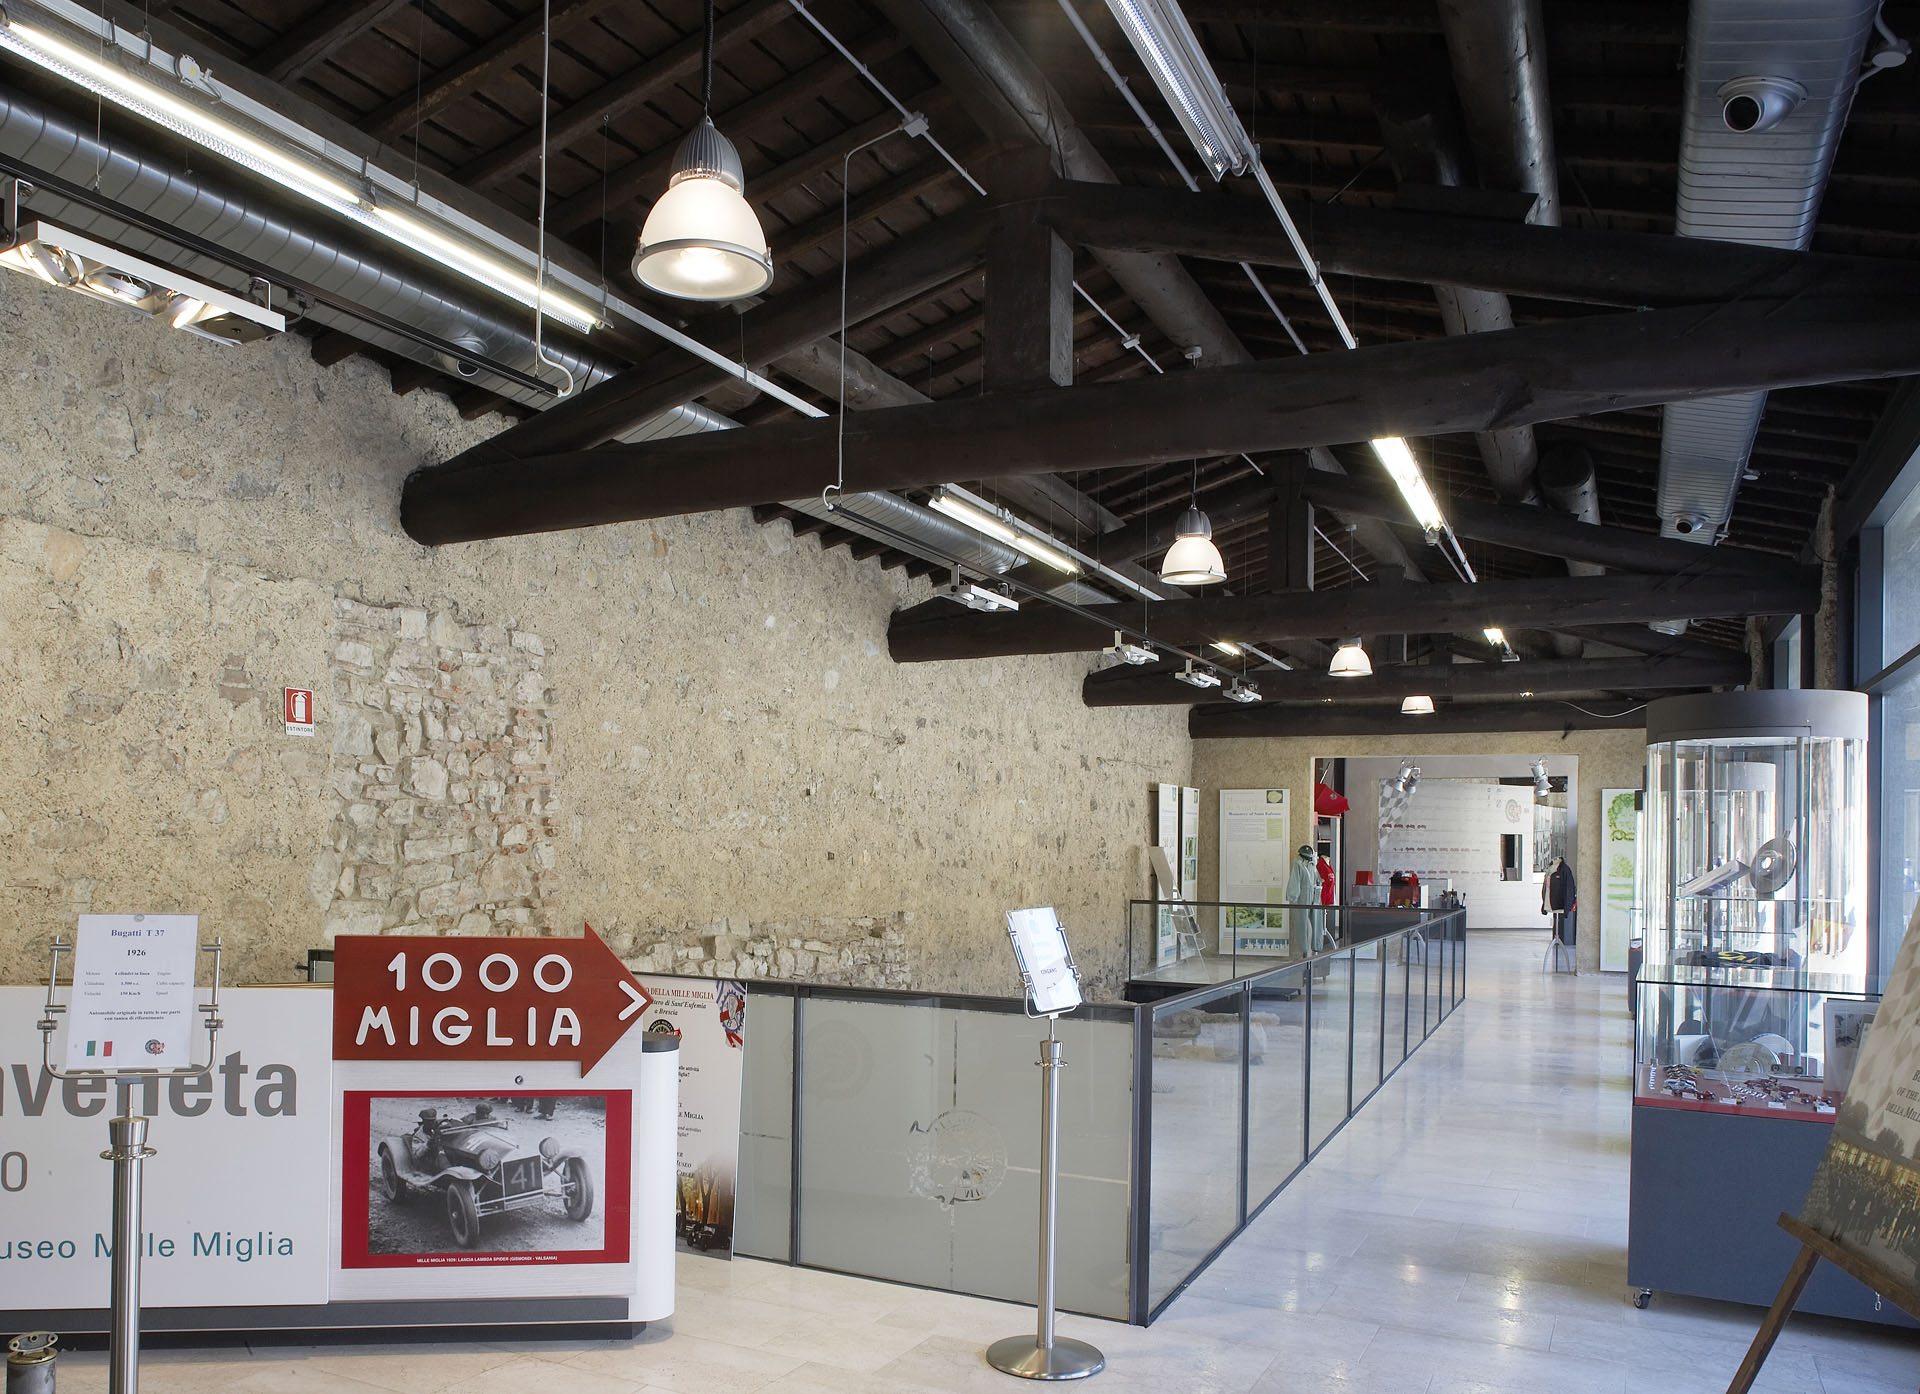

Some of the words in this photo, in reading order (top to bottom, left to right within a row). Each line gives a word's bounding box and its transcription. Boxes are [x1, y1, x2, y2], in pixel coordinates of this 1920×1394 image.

[111, 929, 142, 938] Bugatti
[388, 952, 573, 993] 1000
[650, 988, 670, 996] DELLA
[671, 990, 690, 998] MILLE
[692, 991, 714, 1000] MIGLIA
[355, 1005, 582, 1047] MIGLIA
[510, 1162, 536, 1190] 41
[193, 1230, 294, 1263] Miglia
